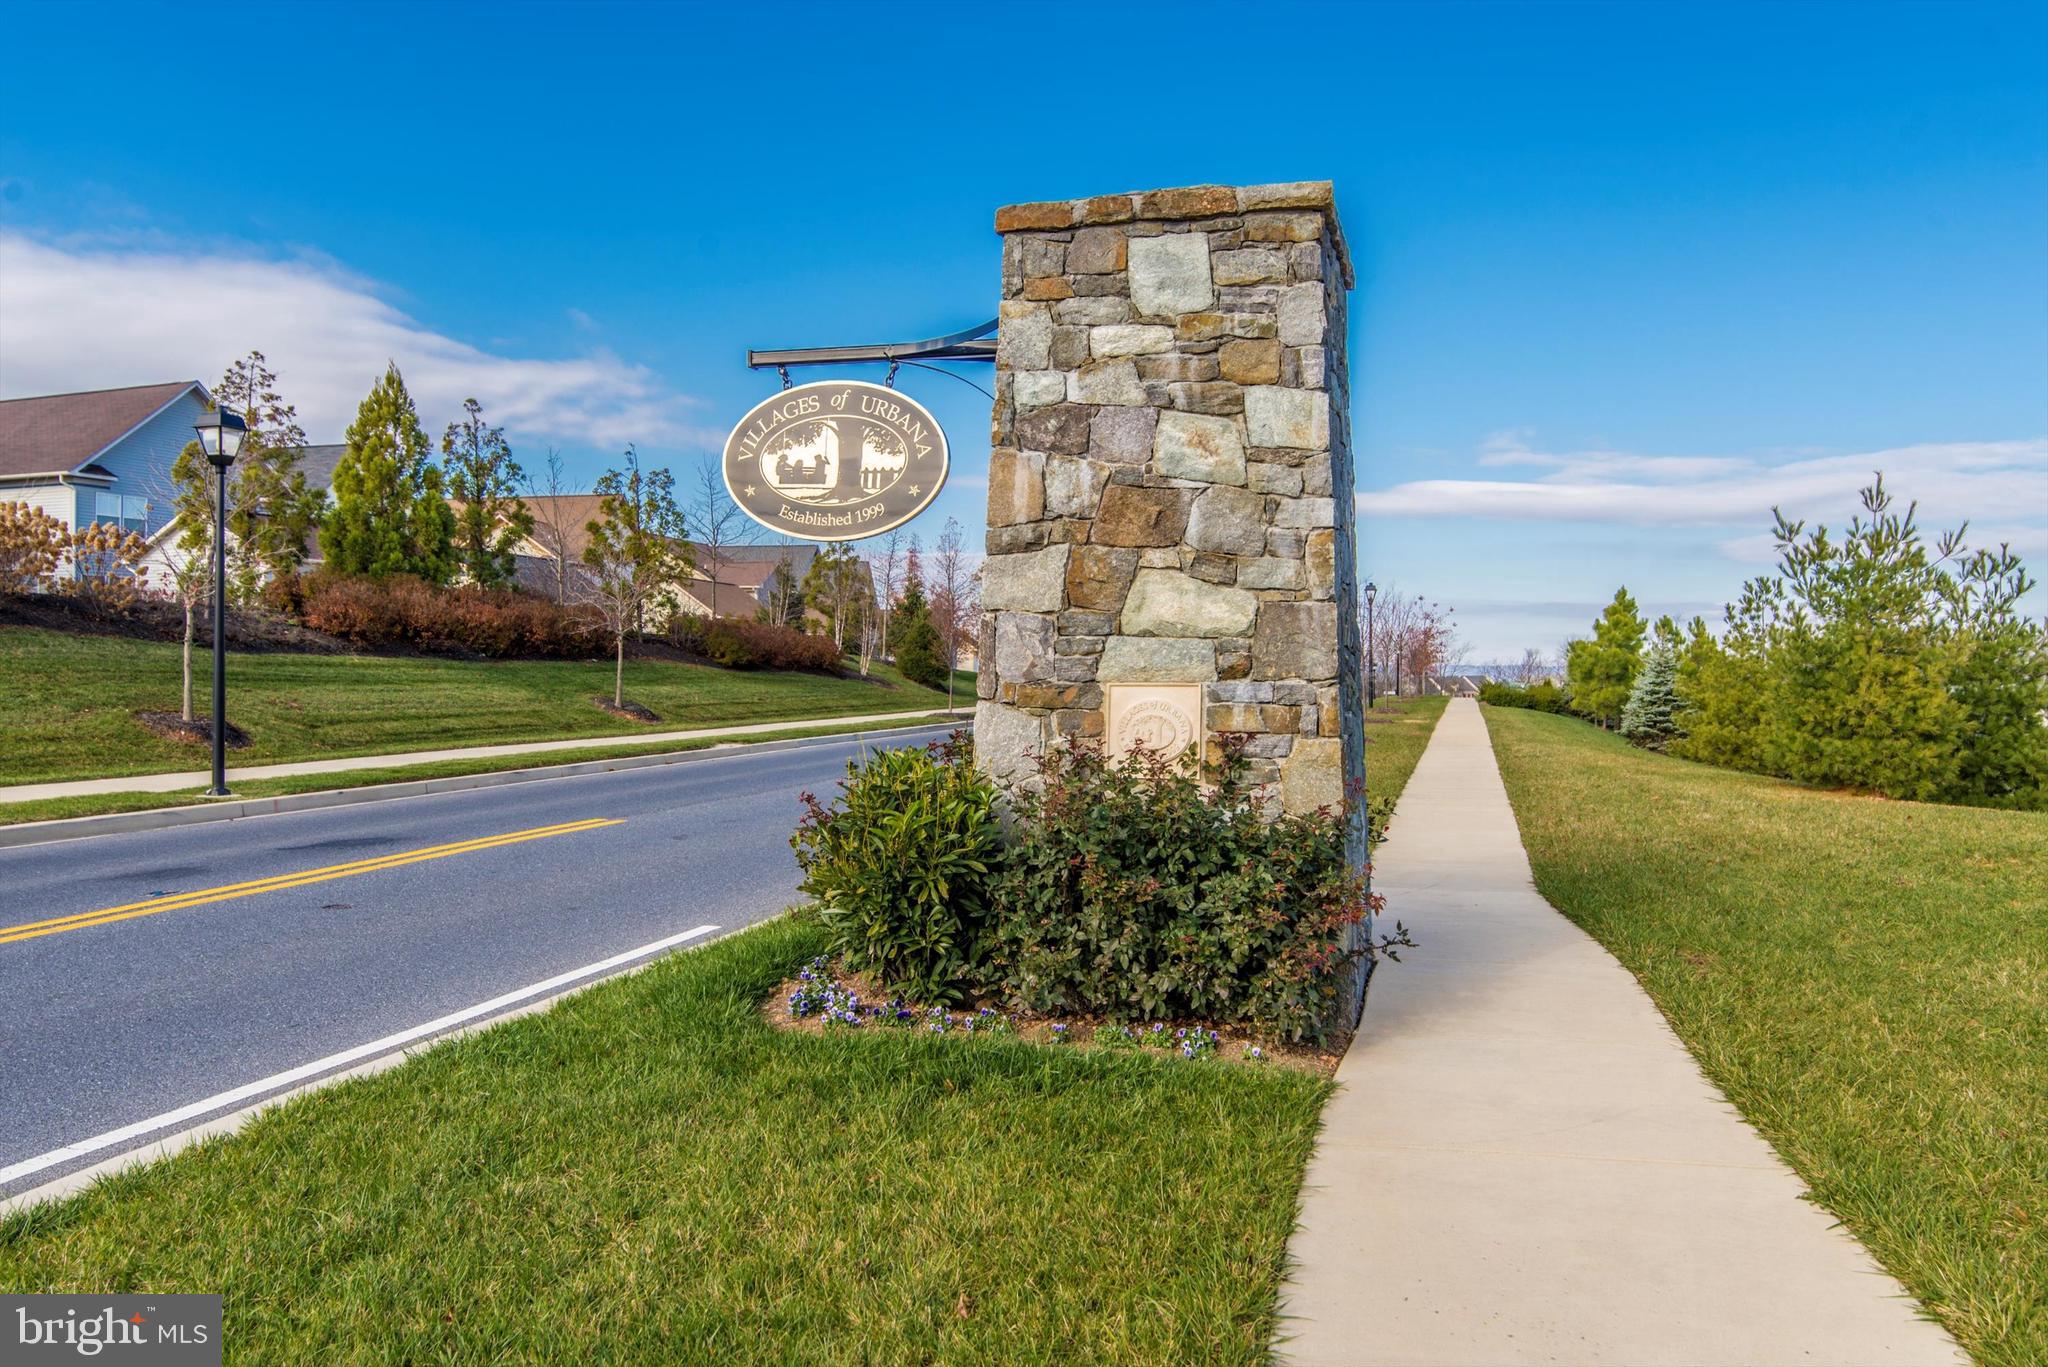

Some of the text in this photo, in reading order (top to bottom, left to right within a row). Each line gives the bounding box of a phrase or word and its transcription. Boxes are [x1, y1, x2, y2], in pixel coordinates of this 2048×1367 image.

[738, 389, 932, 463] VILLAGES of URBANA
[778, 502, 885, 526] Established 1999
